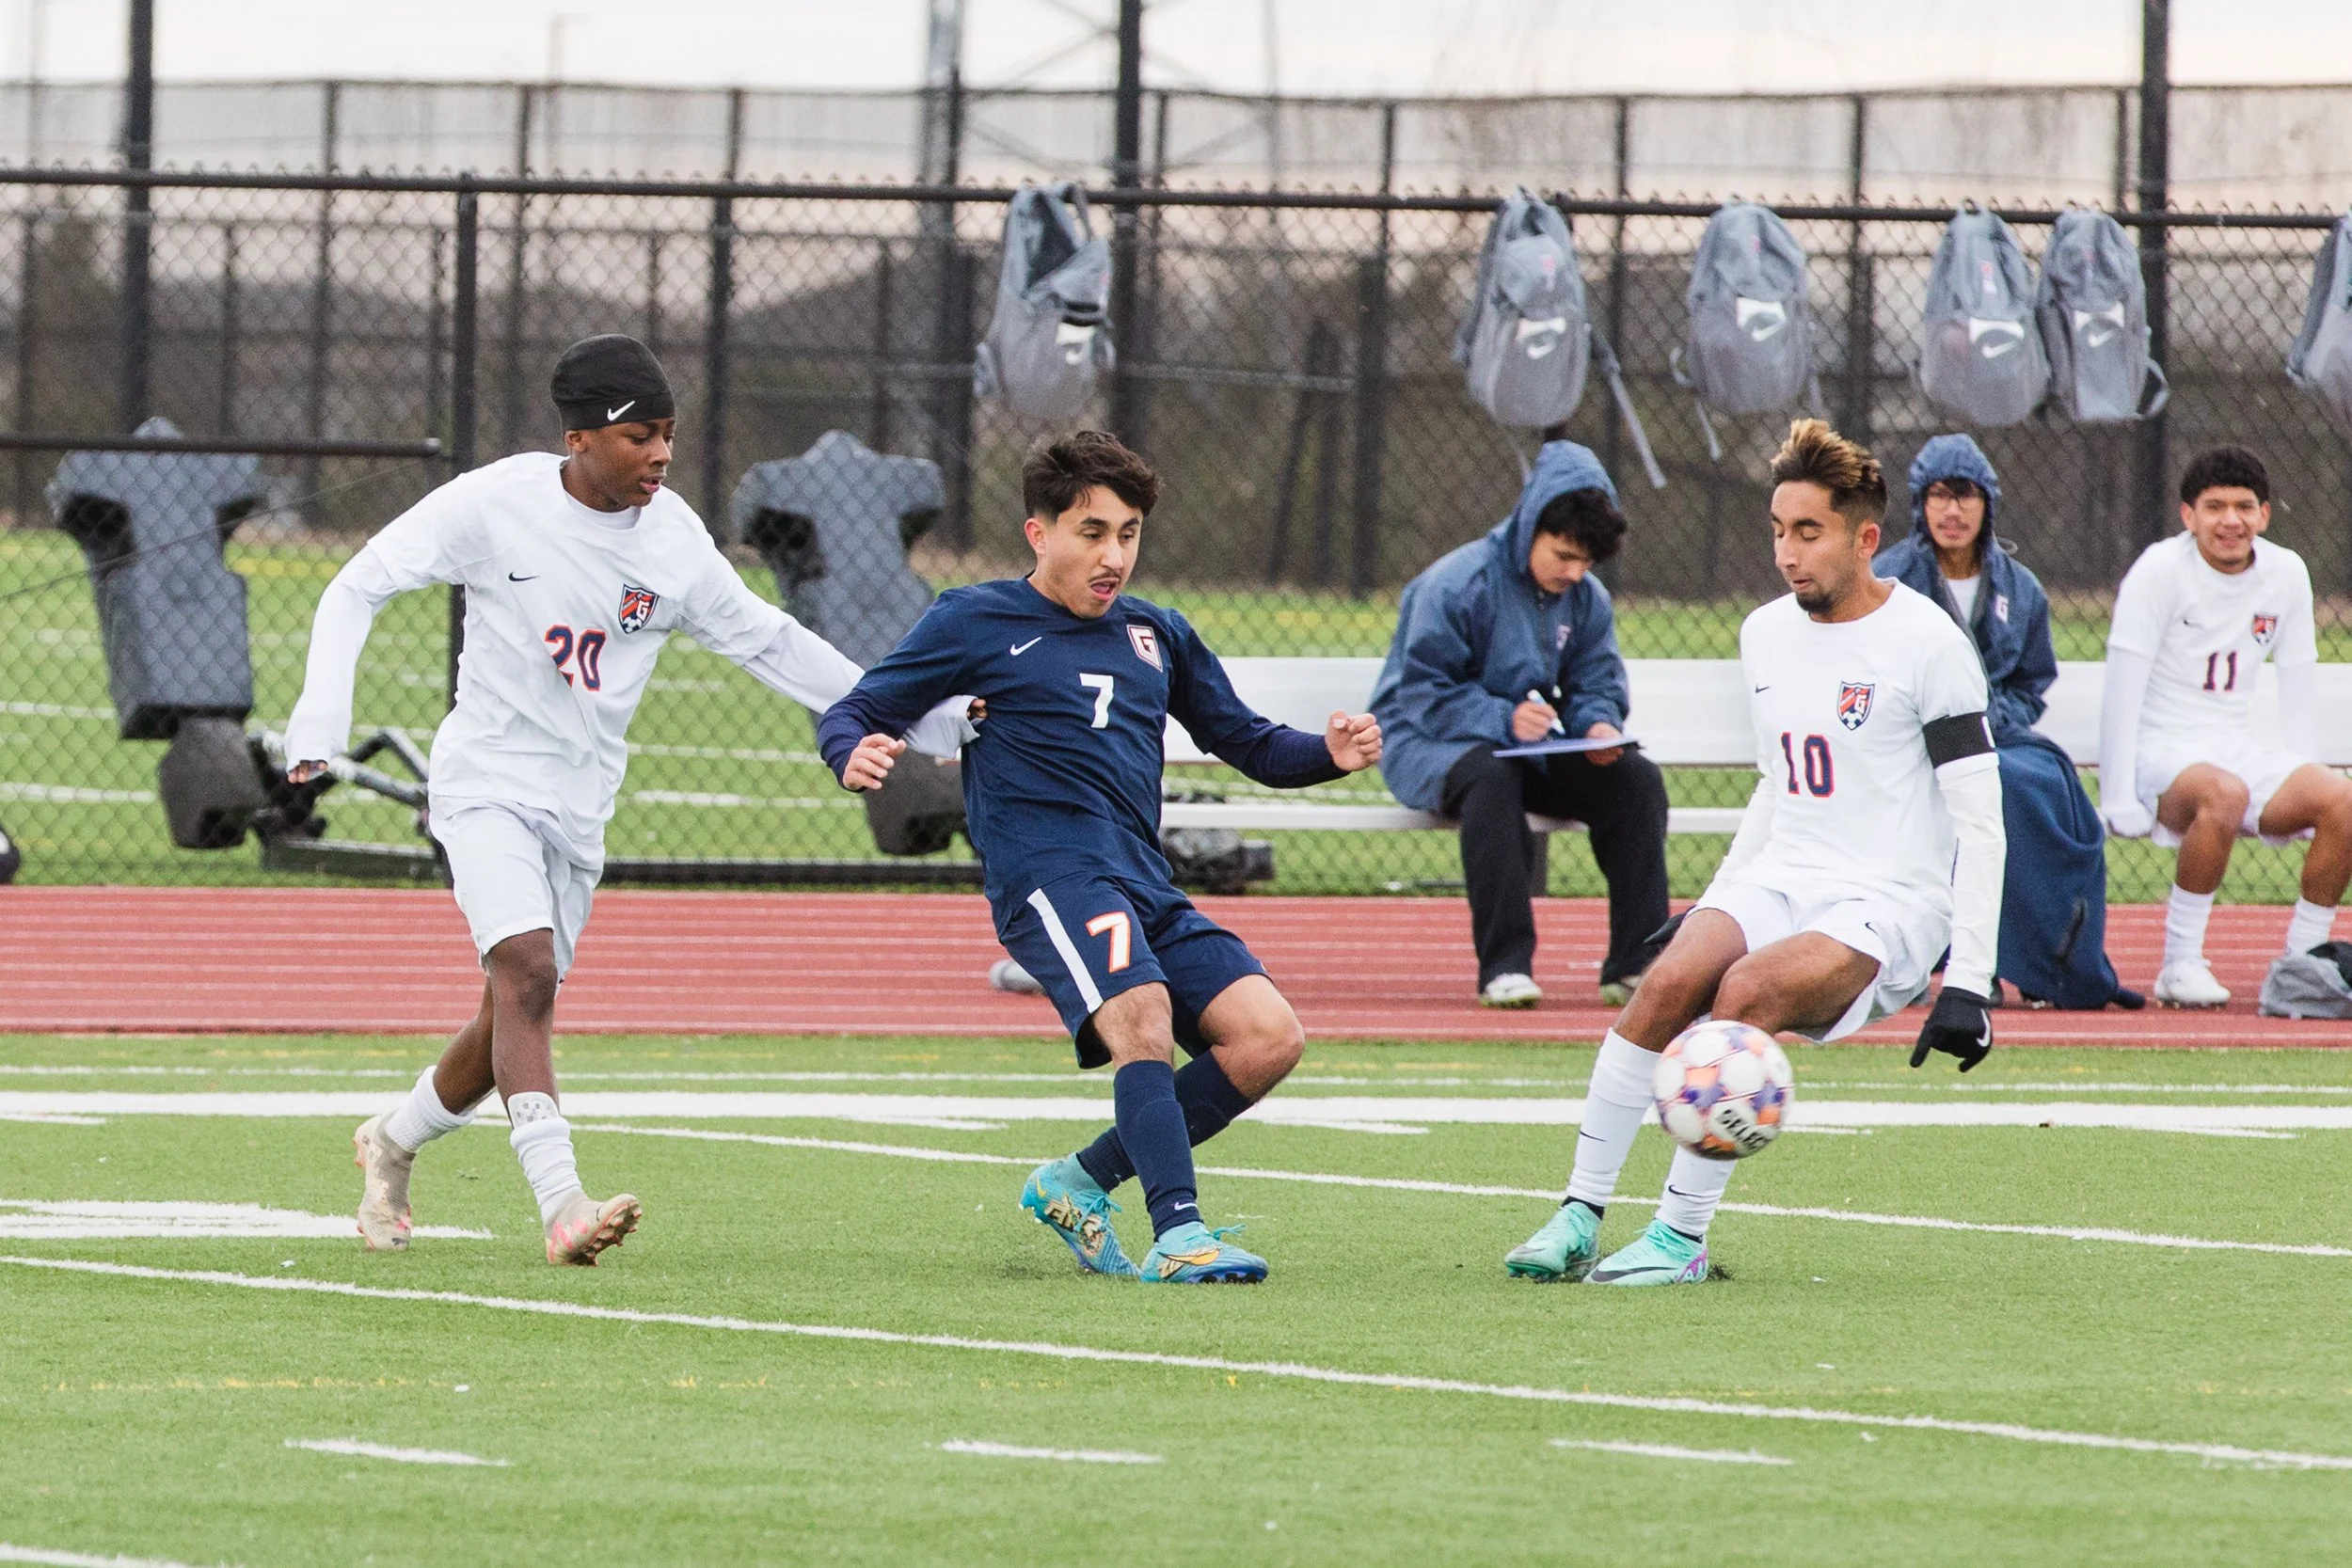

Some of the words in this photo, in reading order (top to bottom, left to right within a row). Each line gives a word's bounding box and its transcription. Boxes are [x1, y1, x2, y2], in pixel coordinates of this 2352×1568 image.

[636, 599, 650, 622] G
[544, 624, 607, 691] 20
[1126, 625, 1163, 673] G
[2202, 650, 2237, 691] 11
[1079, 673, 1114, 729] 7
[1853, 693, 1867, 714] G
[1781, 731, 1835, 798] 10
[1085, 910, 1131, 974] 7
[1717, 1108, 1772, 1150] SELEC
